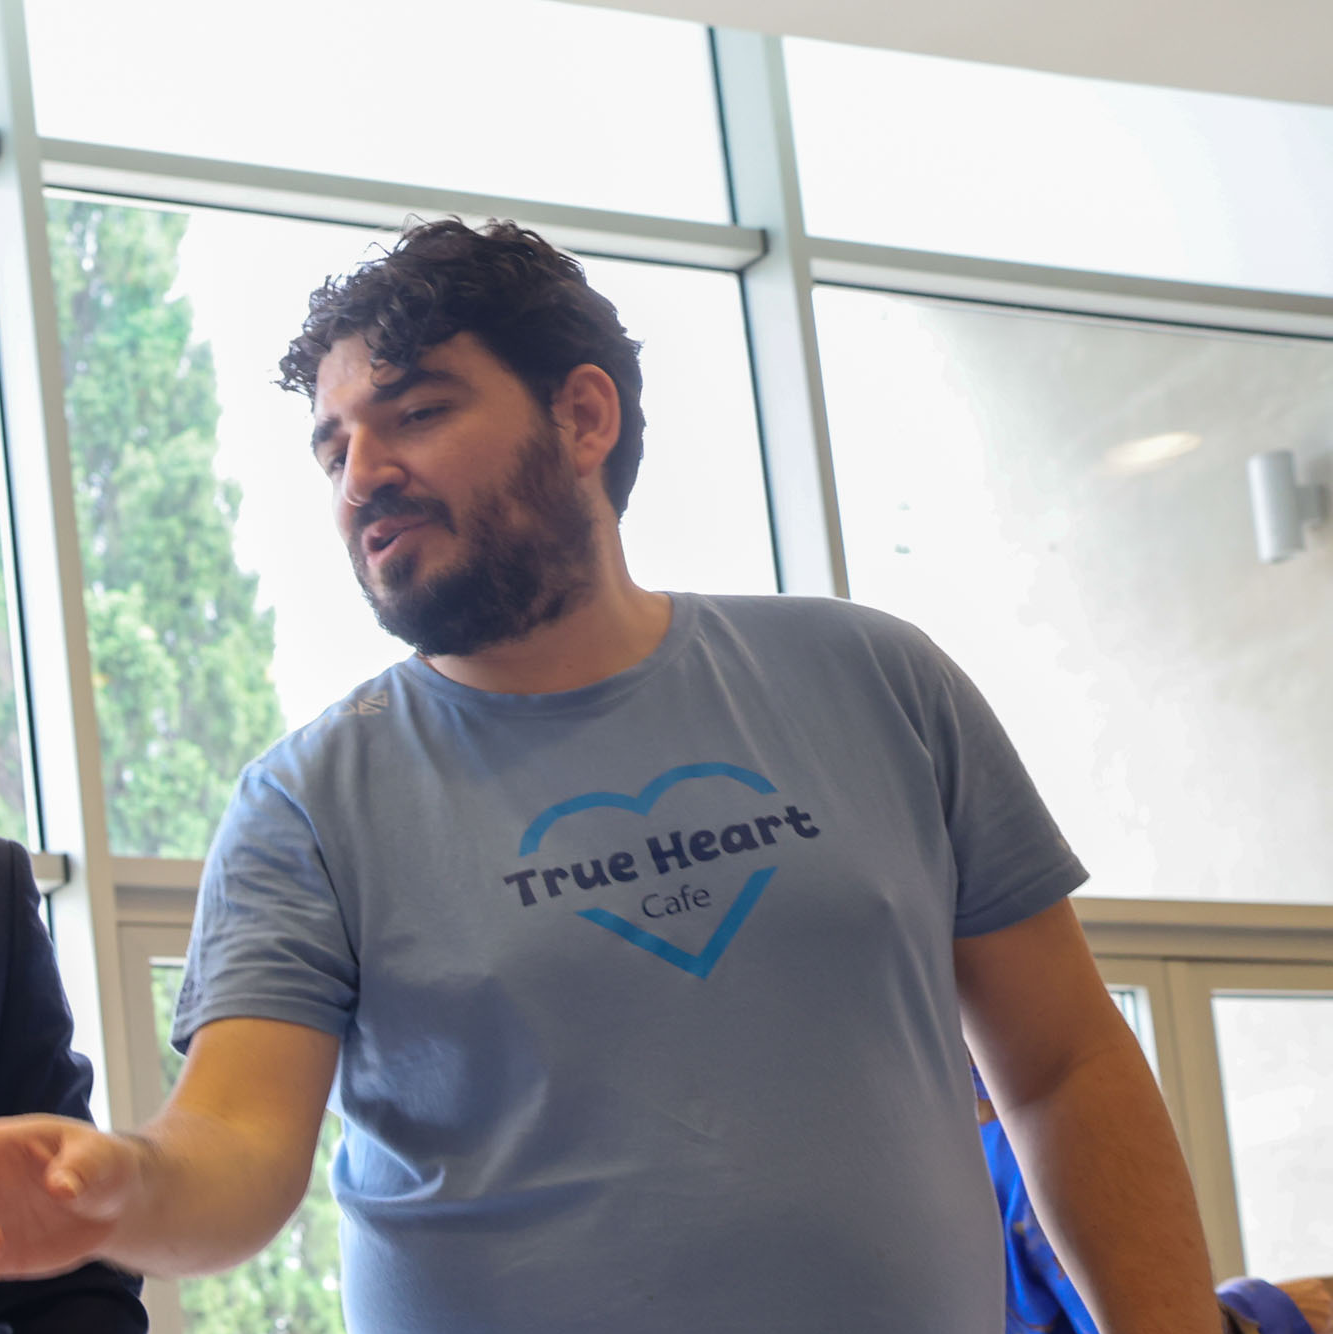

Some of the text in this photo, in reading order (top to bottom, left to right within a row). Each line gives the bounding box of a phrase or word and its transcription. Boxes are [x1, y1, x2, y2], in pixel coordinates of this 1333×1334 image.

[503, 805, 820, 908] True Heart
[641, 884, 712, 920] Cafe
